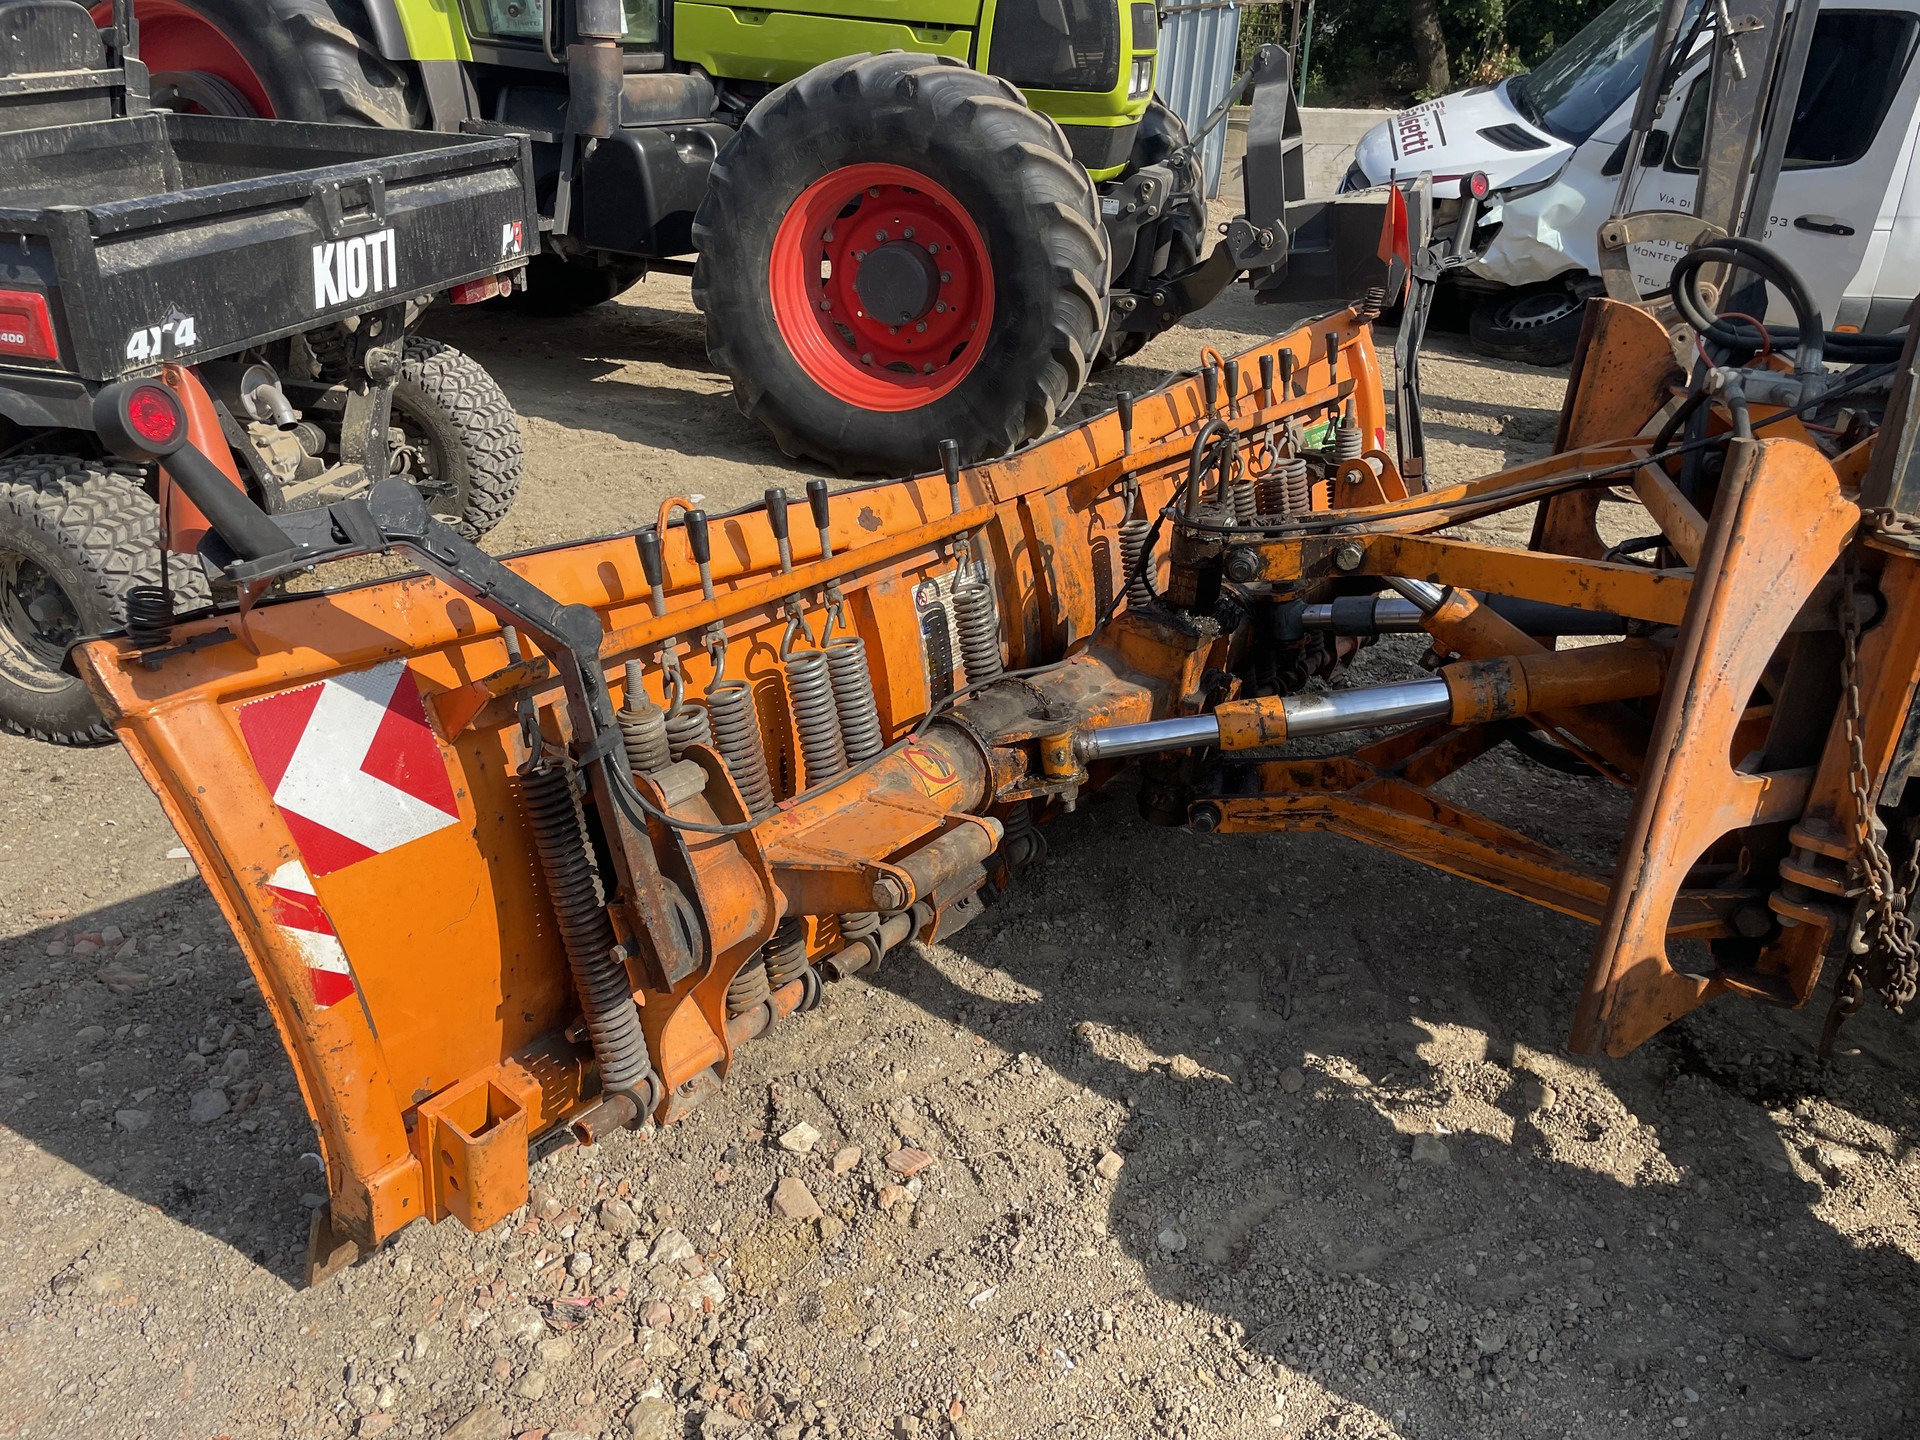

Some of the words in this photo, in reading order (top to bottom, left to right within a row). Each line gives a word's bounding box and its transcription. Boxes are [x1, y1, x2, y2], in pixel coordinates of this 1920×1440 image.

[1397, 110, 1434, 157] alsetti
[1659, 192, 1675, 205] VIA
[1679, 199, 1691, 208] DI
[1769, 215, 1789, 228] 93
[1633, 244, 1678, 264] MONTER
[313, 228, 397, 310] KIOTI
[1637, 274, 1660, 287] TEL.
[0, 332, 25, 344] 400
